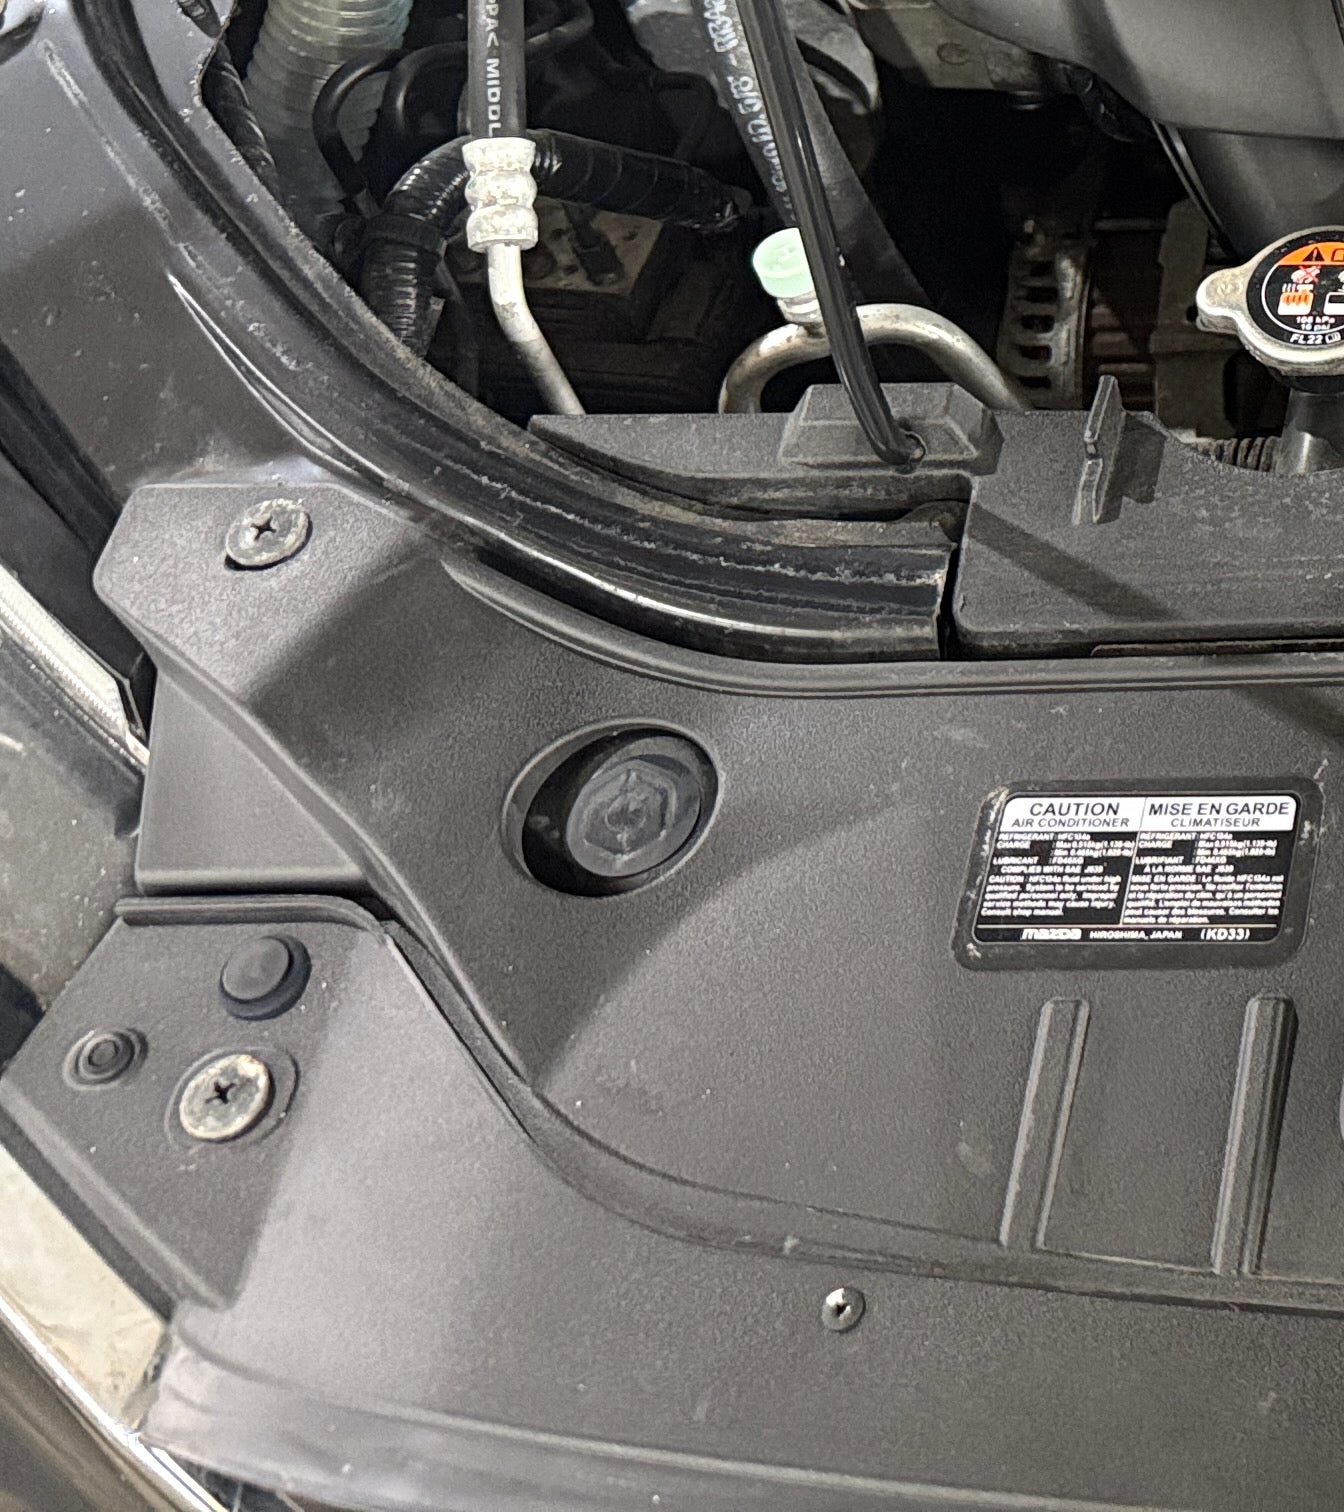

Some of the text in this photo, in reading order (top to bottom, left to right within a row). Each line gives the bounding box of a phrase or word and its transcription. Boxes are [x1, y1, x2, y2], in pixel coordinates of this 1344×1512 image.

[1290, 334, 1323, 344] FL22
[1030, 802, 1120, 816] CAUTION
[1149, 802, 1289, 816] MISE EN GARDE
[1012, 818, 1130, 828] AIR CONDITIONER
[1171, 818, 1260, 827] CLIMATISEUR
[1021, 928, 1250, 940] mazda HIROSHIMA, JAPAN (KD33)
